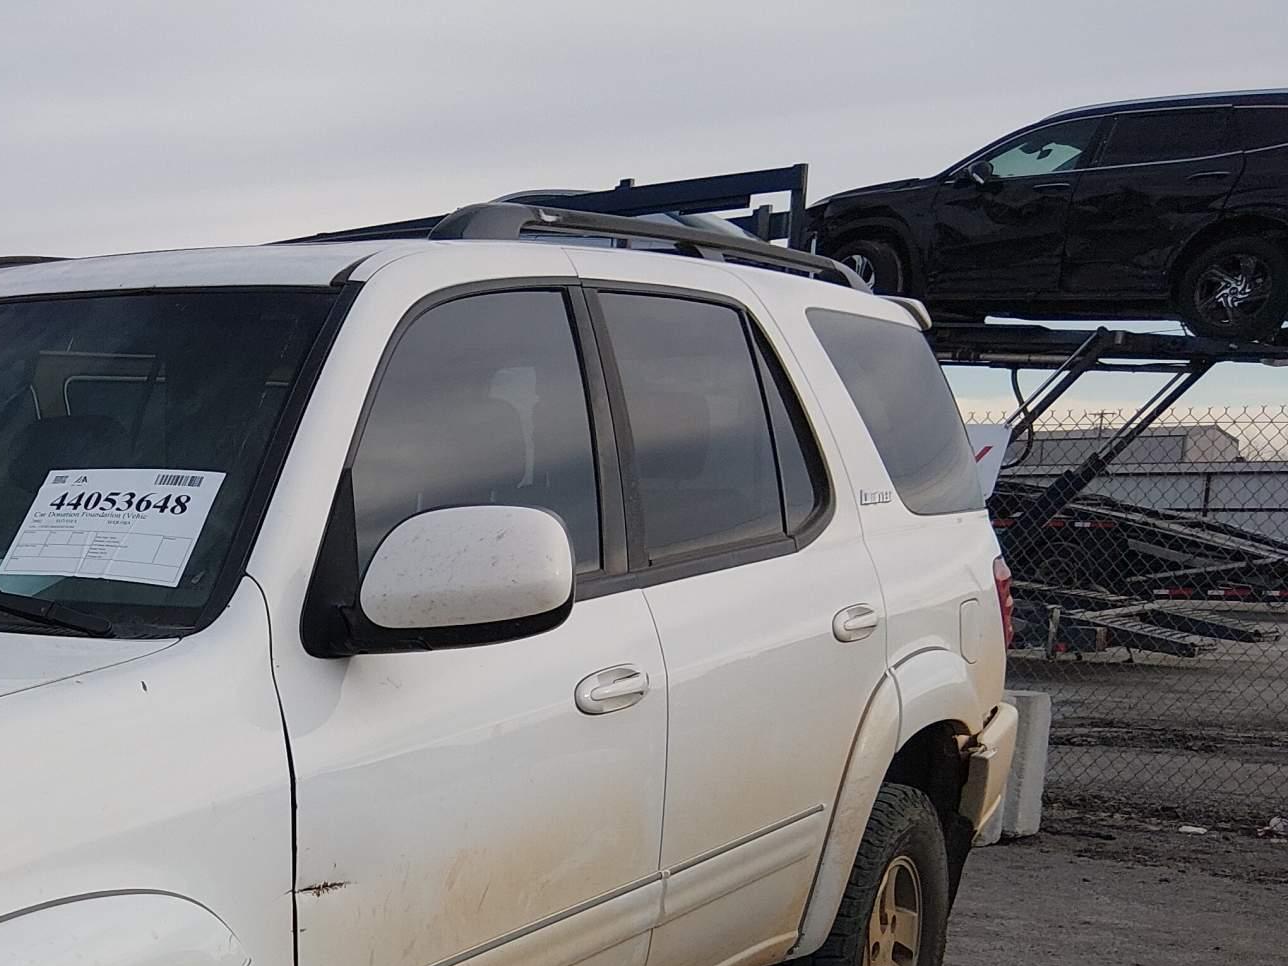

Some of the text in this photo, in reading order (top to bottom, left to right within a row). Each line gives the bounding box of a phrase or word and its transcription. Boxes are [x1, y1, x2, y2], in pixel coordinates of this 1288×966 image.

[50, 491, 192, 515] 44053648
[34, 511, 47, 519] Car
[81, 511, 121, 519] Foundation
